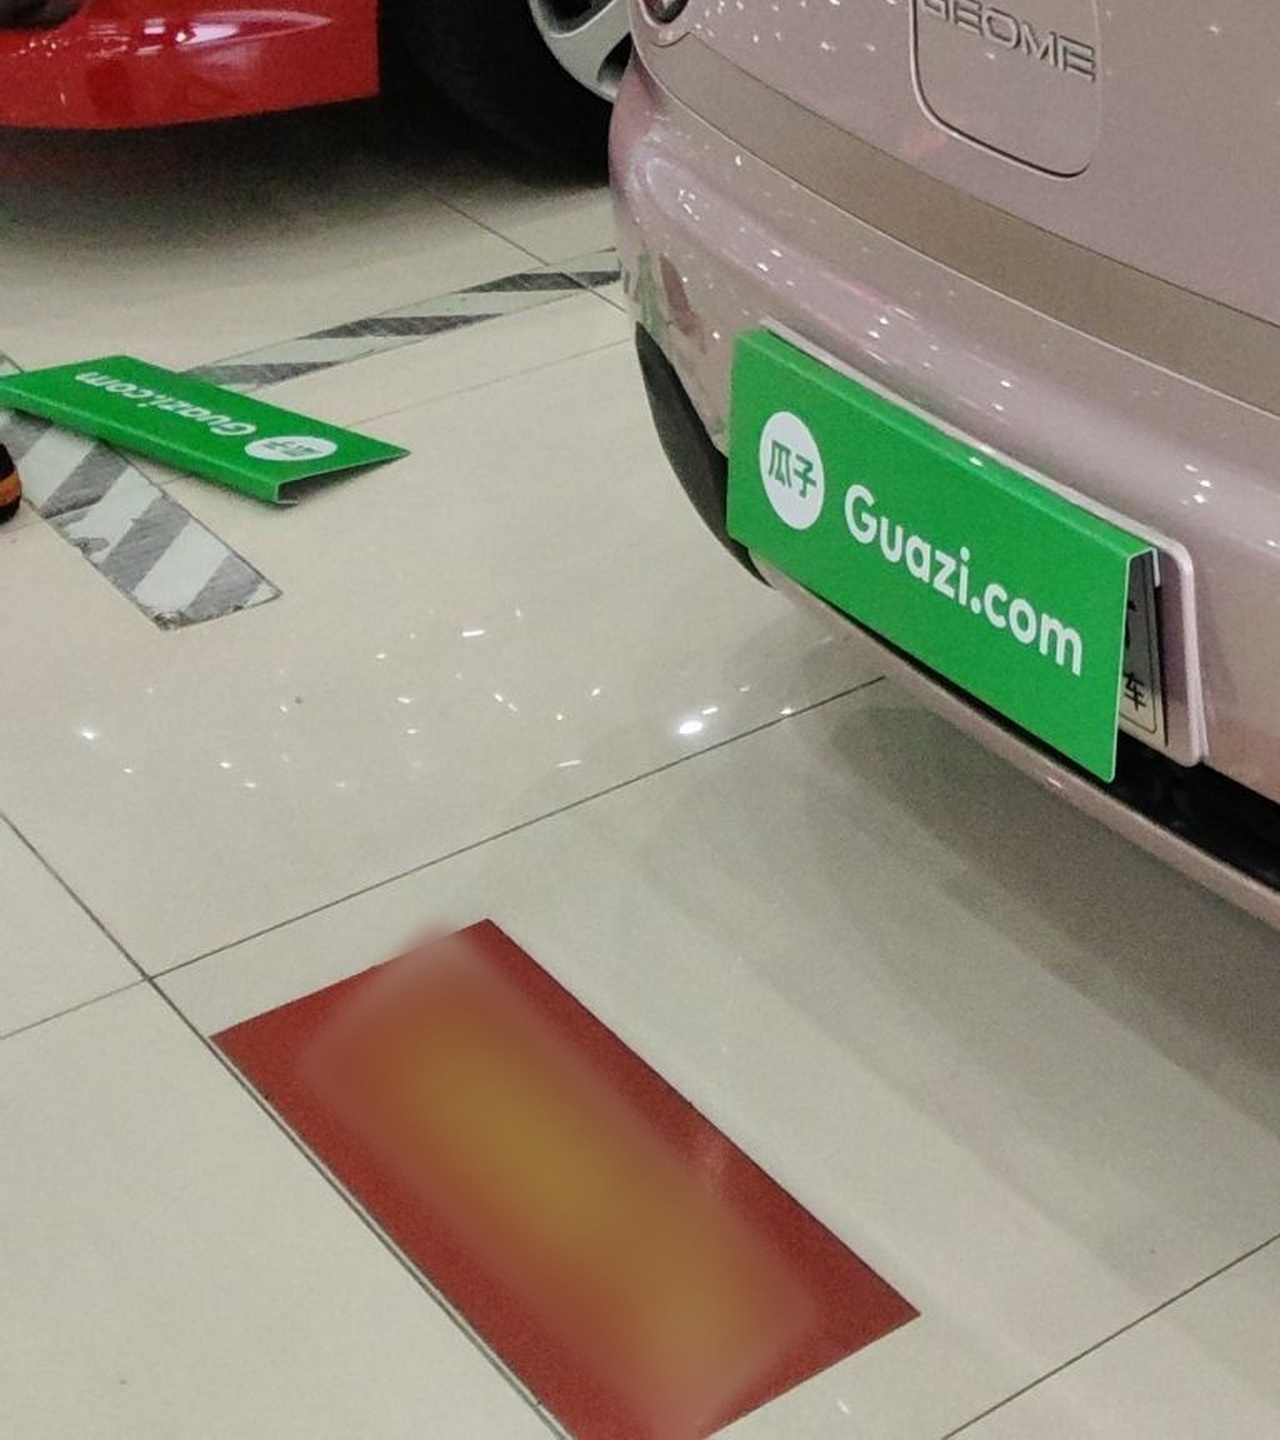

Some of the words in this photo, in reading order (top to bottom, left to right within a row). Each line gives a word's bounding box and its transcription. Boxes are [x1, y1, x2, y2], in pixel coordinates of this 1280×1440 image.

[75, 372, 257, 436] Guazi.com
[767, 438, 818, 498] 瓜子
[845, 484, 1082, 677] Guazi.com
